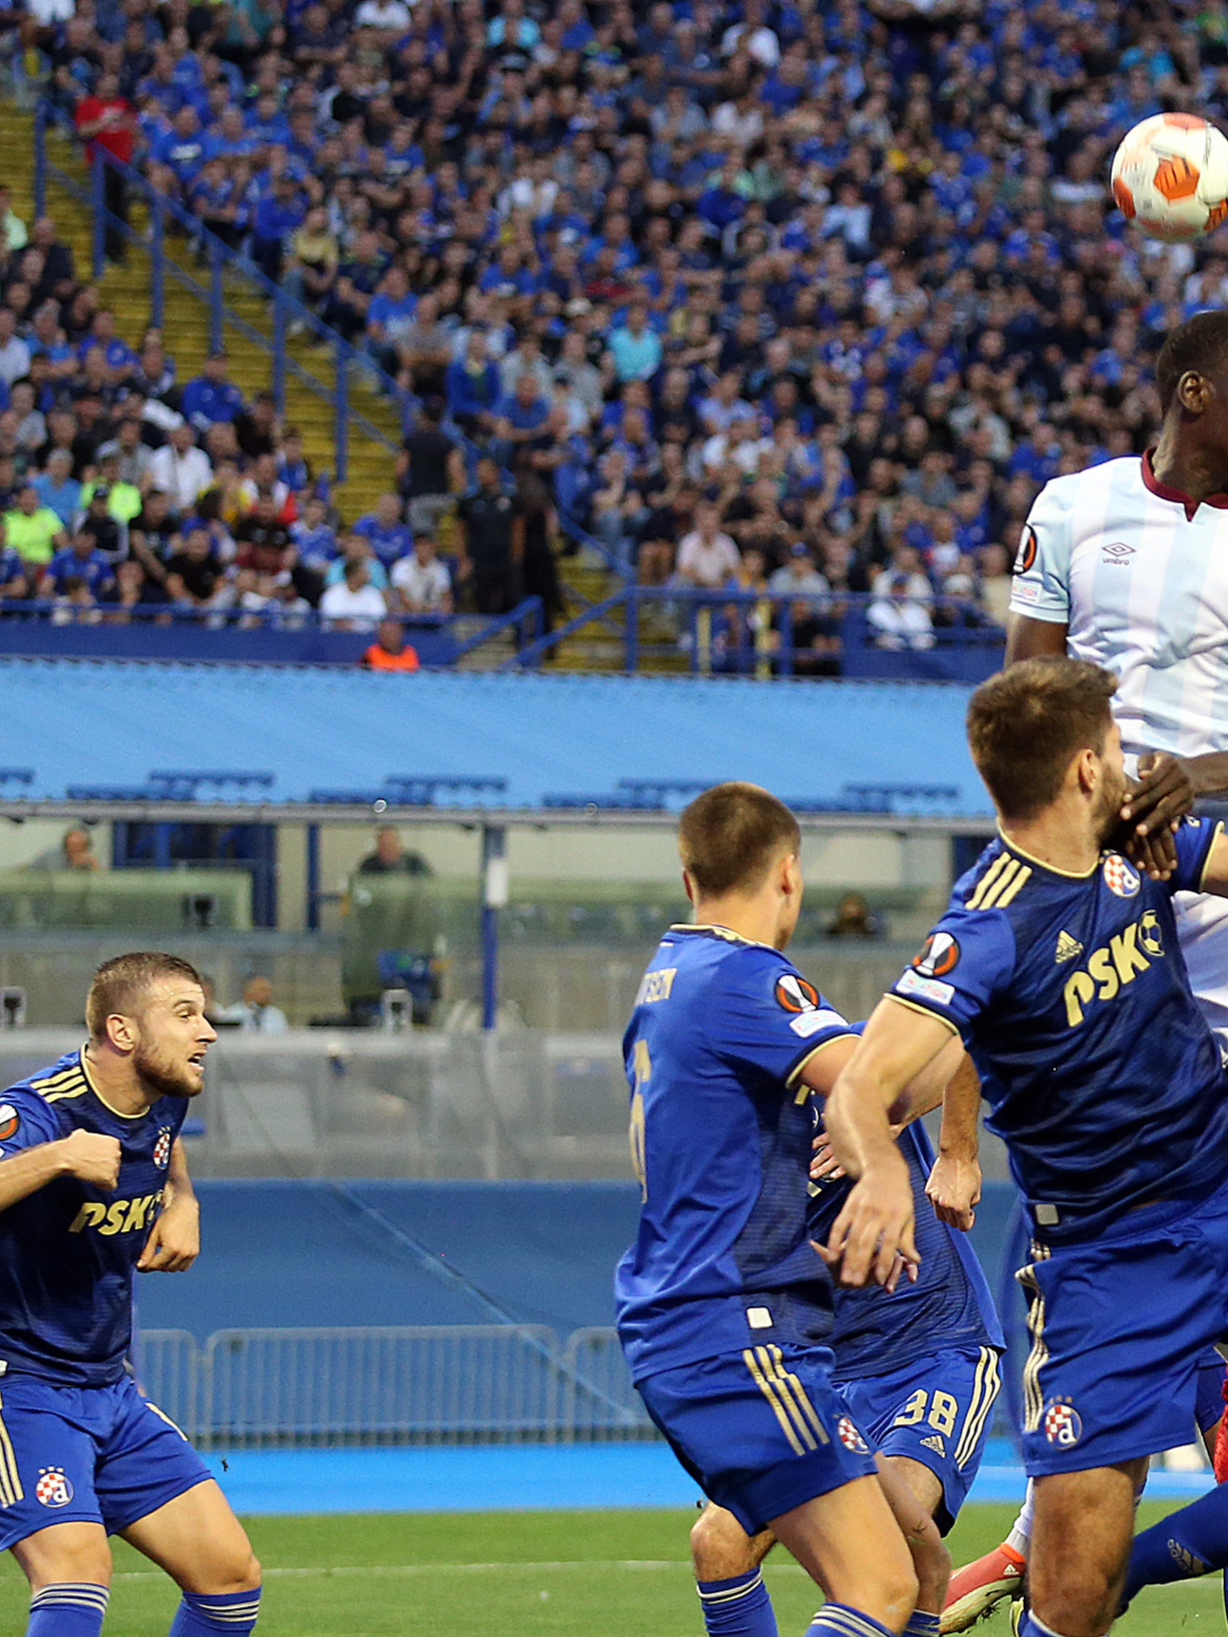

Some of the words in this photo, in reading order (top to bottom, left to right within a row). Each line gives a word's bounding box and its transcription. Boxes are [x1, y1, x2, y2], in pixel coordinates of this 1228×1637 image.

[1064, 922, 1151, 1027] PSK
[68, 1195, 154, 1236] PSK
[893, 1388, 959, 1438] 38
